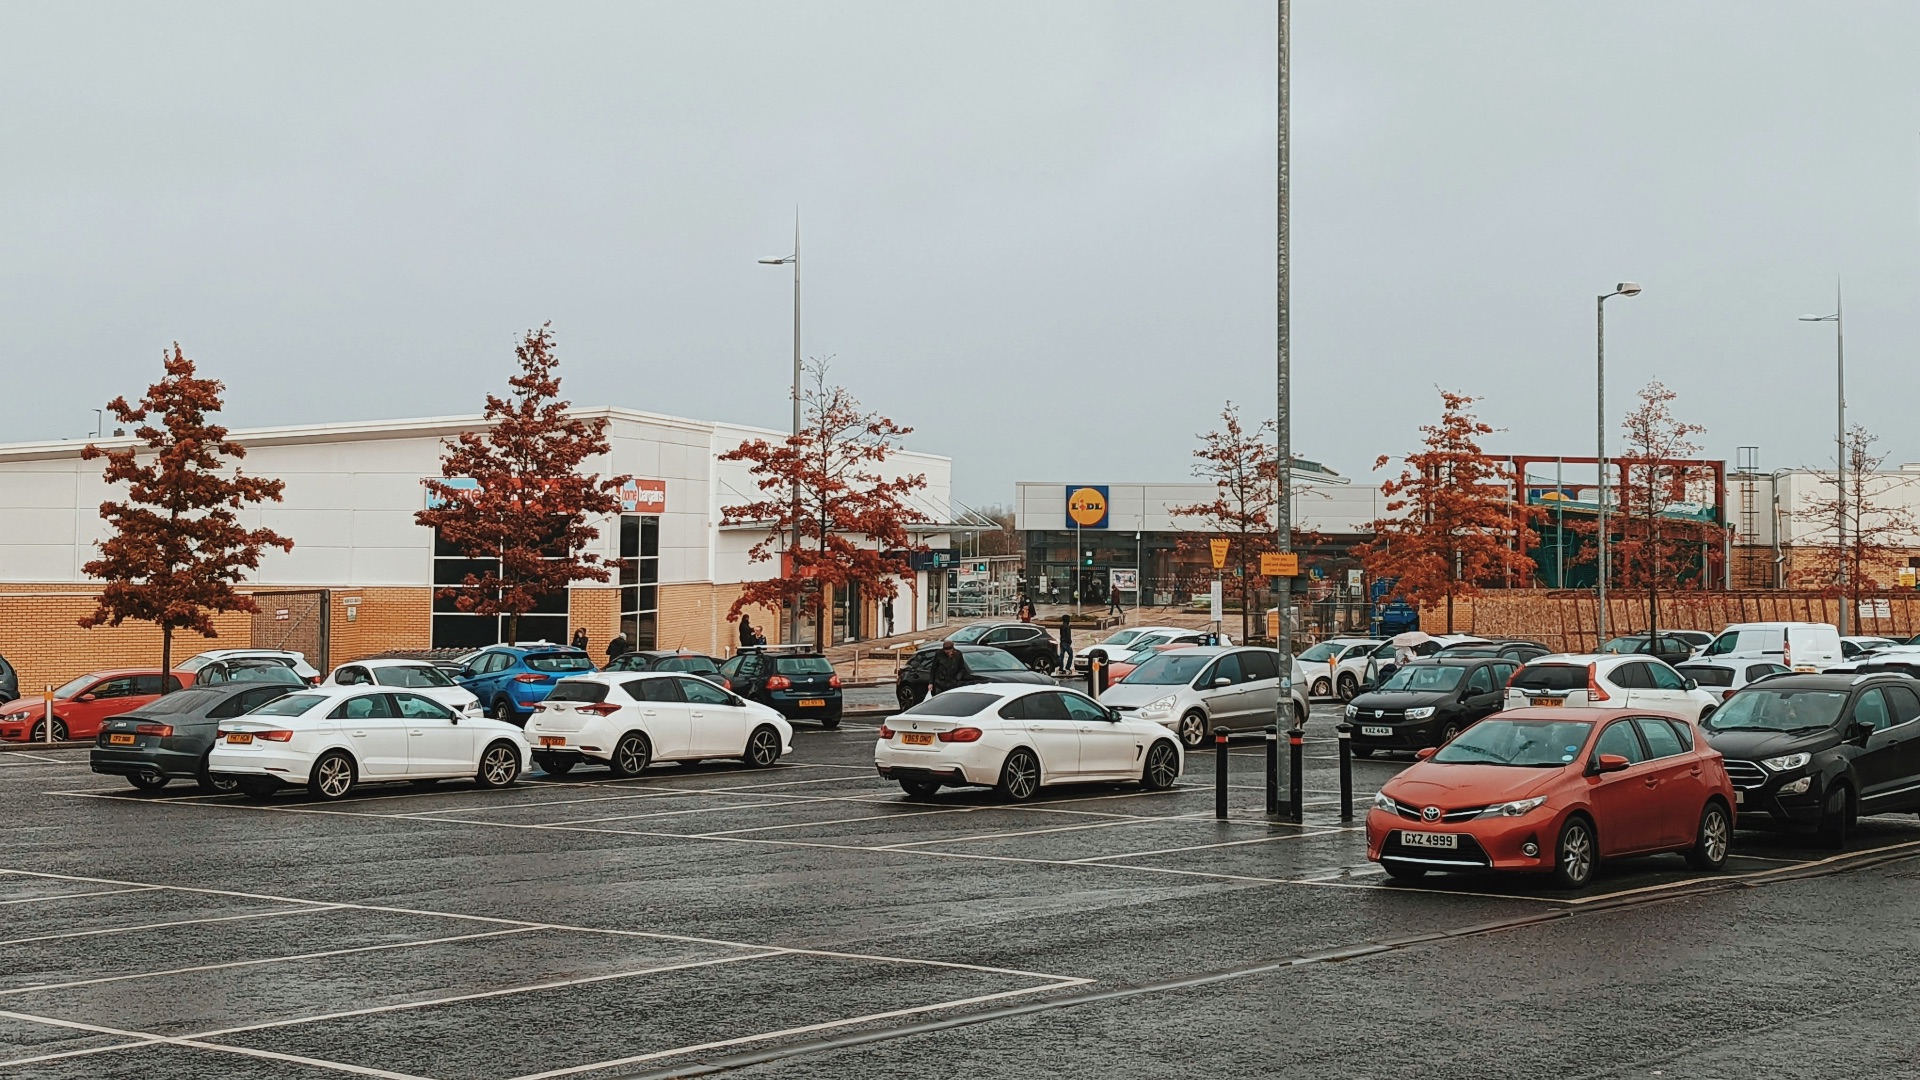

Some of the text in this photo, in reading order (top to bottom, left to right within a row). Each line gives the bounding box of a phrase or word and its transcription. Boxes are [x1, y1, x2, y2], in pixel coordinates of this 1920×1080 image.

[639, 486, 664, 505] bargains
[1405, 833, 1453, 847] GXZ 4999
